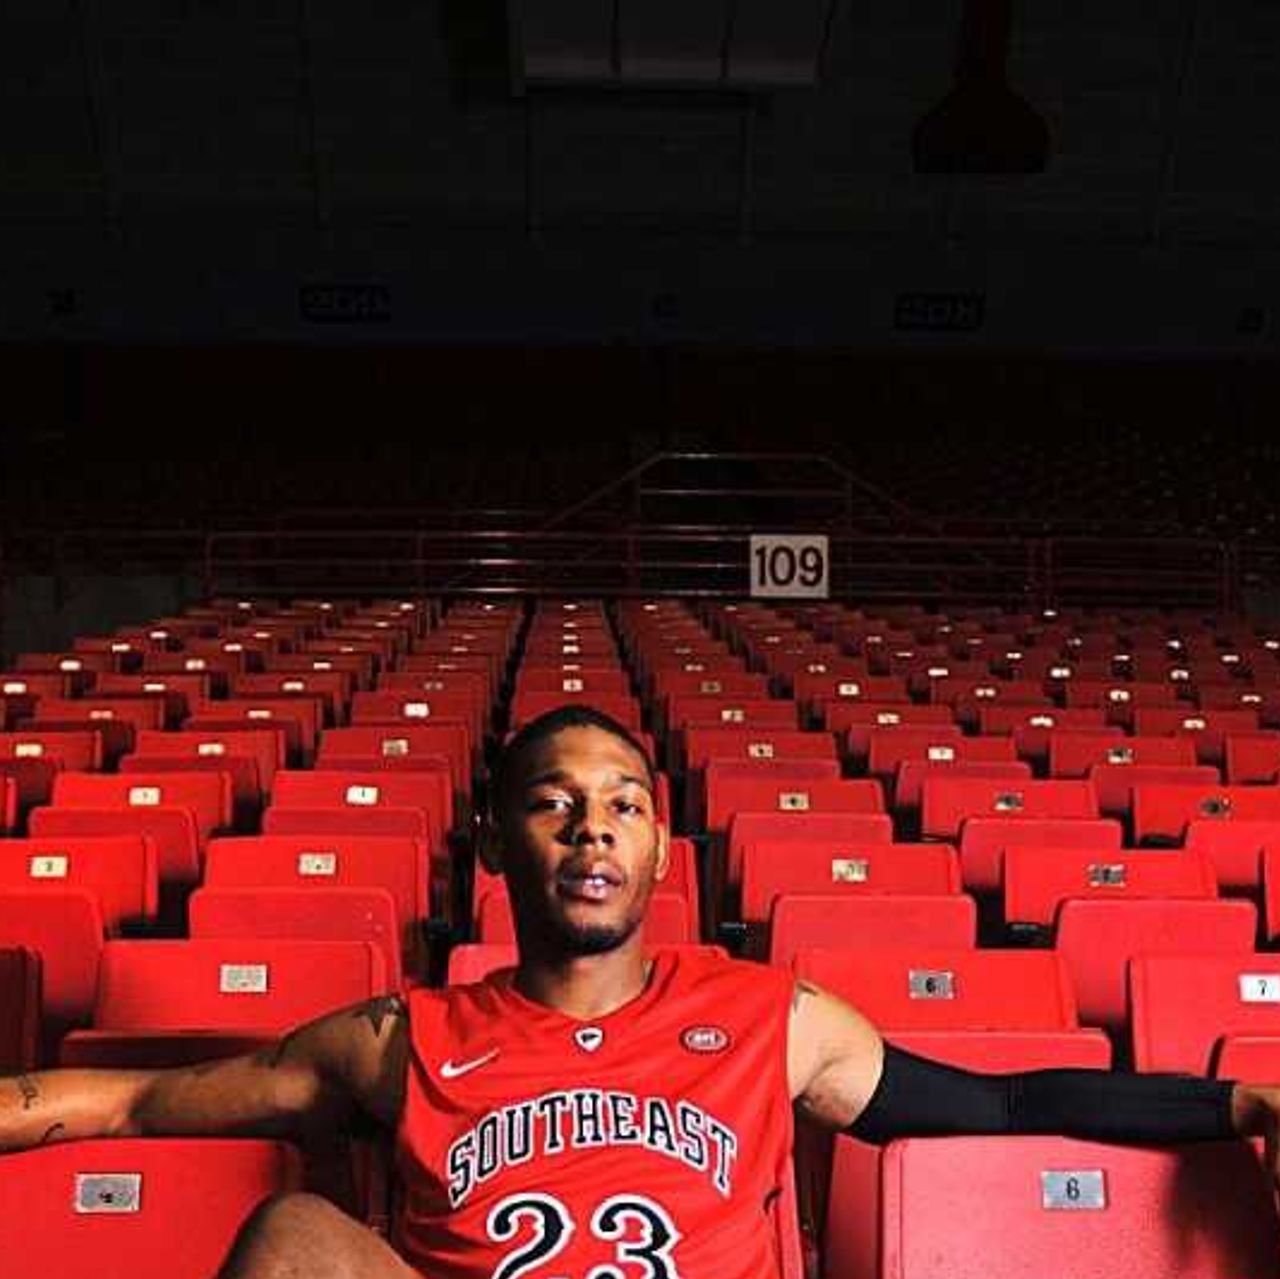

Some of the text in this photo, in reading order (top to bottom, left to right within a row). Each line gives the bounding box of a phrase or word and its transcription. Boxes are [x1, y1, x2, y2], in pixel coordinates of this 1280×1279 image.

[755, 546, 823, 587] 109
[1258, 979, 1268, 997] 7
[447, 1088, 738, 1208] SOUTHEAST
[1065, 1177, 1080, 1201] 6
